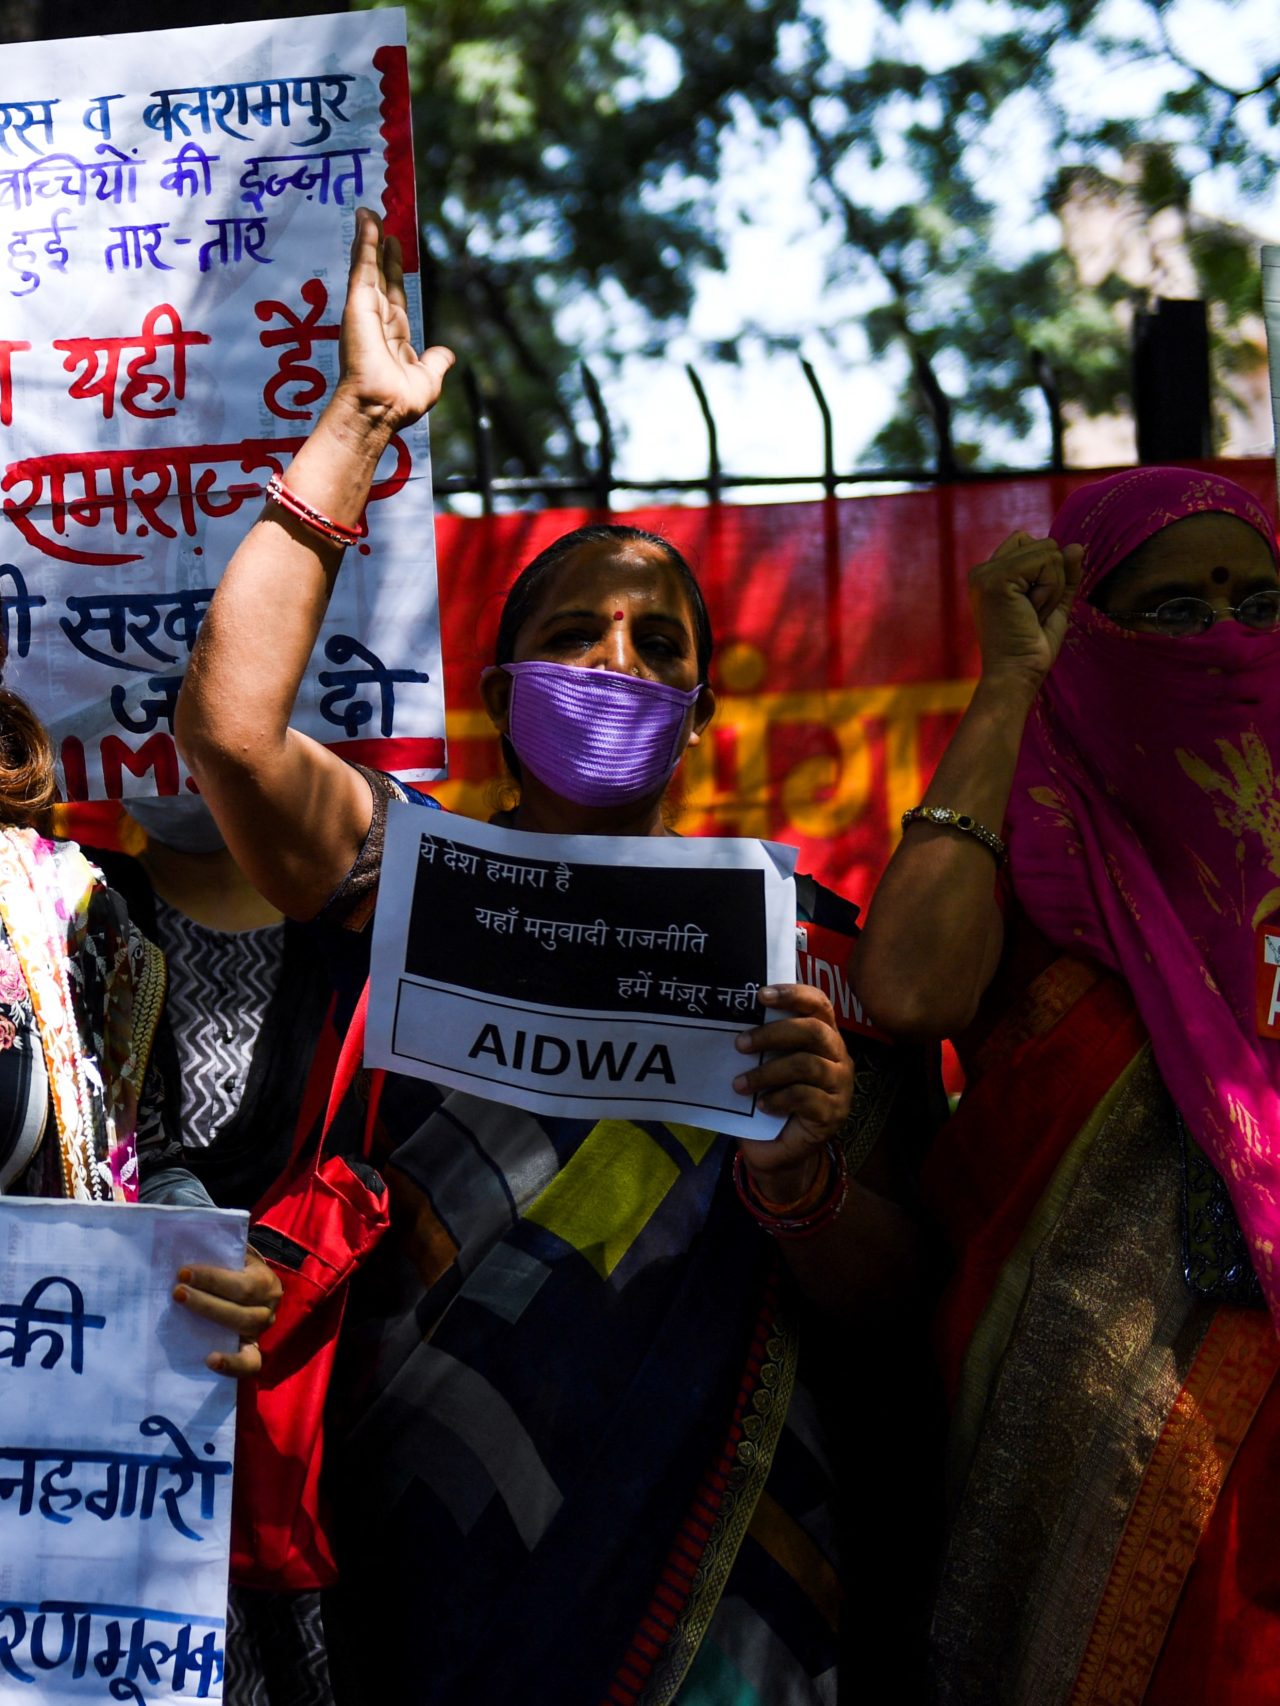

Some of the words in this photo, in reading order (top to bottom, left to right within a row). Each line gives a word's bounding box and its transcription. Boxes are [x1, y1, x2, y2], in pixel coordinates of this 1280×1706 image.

[82, 92, 126, 140] व
[142, 74, 356, 147] बलरामपुर
[160, 142, 220, 198] की
[7, 207, 78, 297] हुई
[52, 303, 213, 419] यही
[318, 634, 431, 738] दो
[420, 834, 439, 864] ये
[443, 840, 480, 875] देश
[485, 858, 549, 888] हमारा
[554, 861, 574, 892] है
[475, 906, 519, 935] यहाँ
[523, 918, 610, 951] मनुवादी
[616, 923, 709, 954] राजनीति
[617, 970, 654, 999] हमें
[717, 982, 760, 1011] नहीं
[468, 1023, 677, 1086] AIDWA
